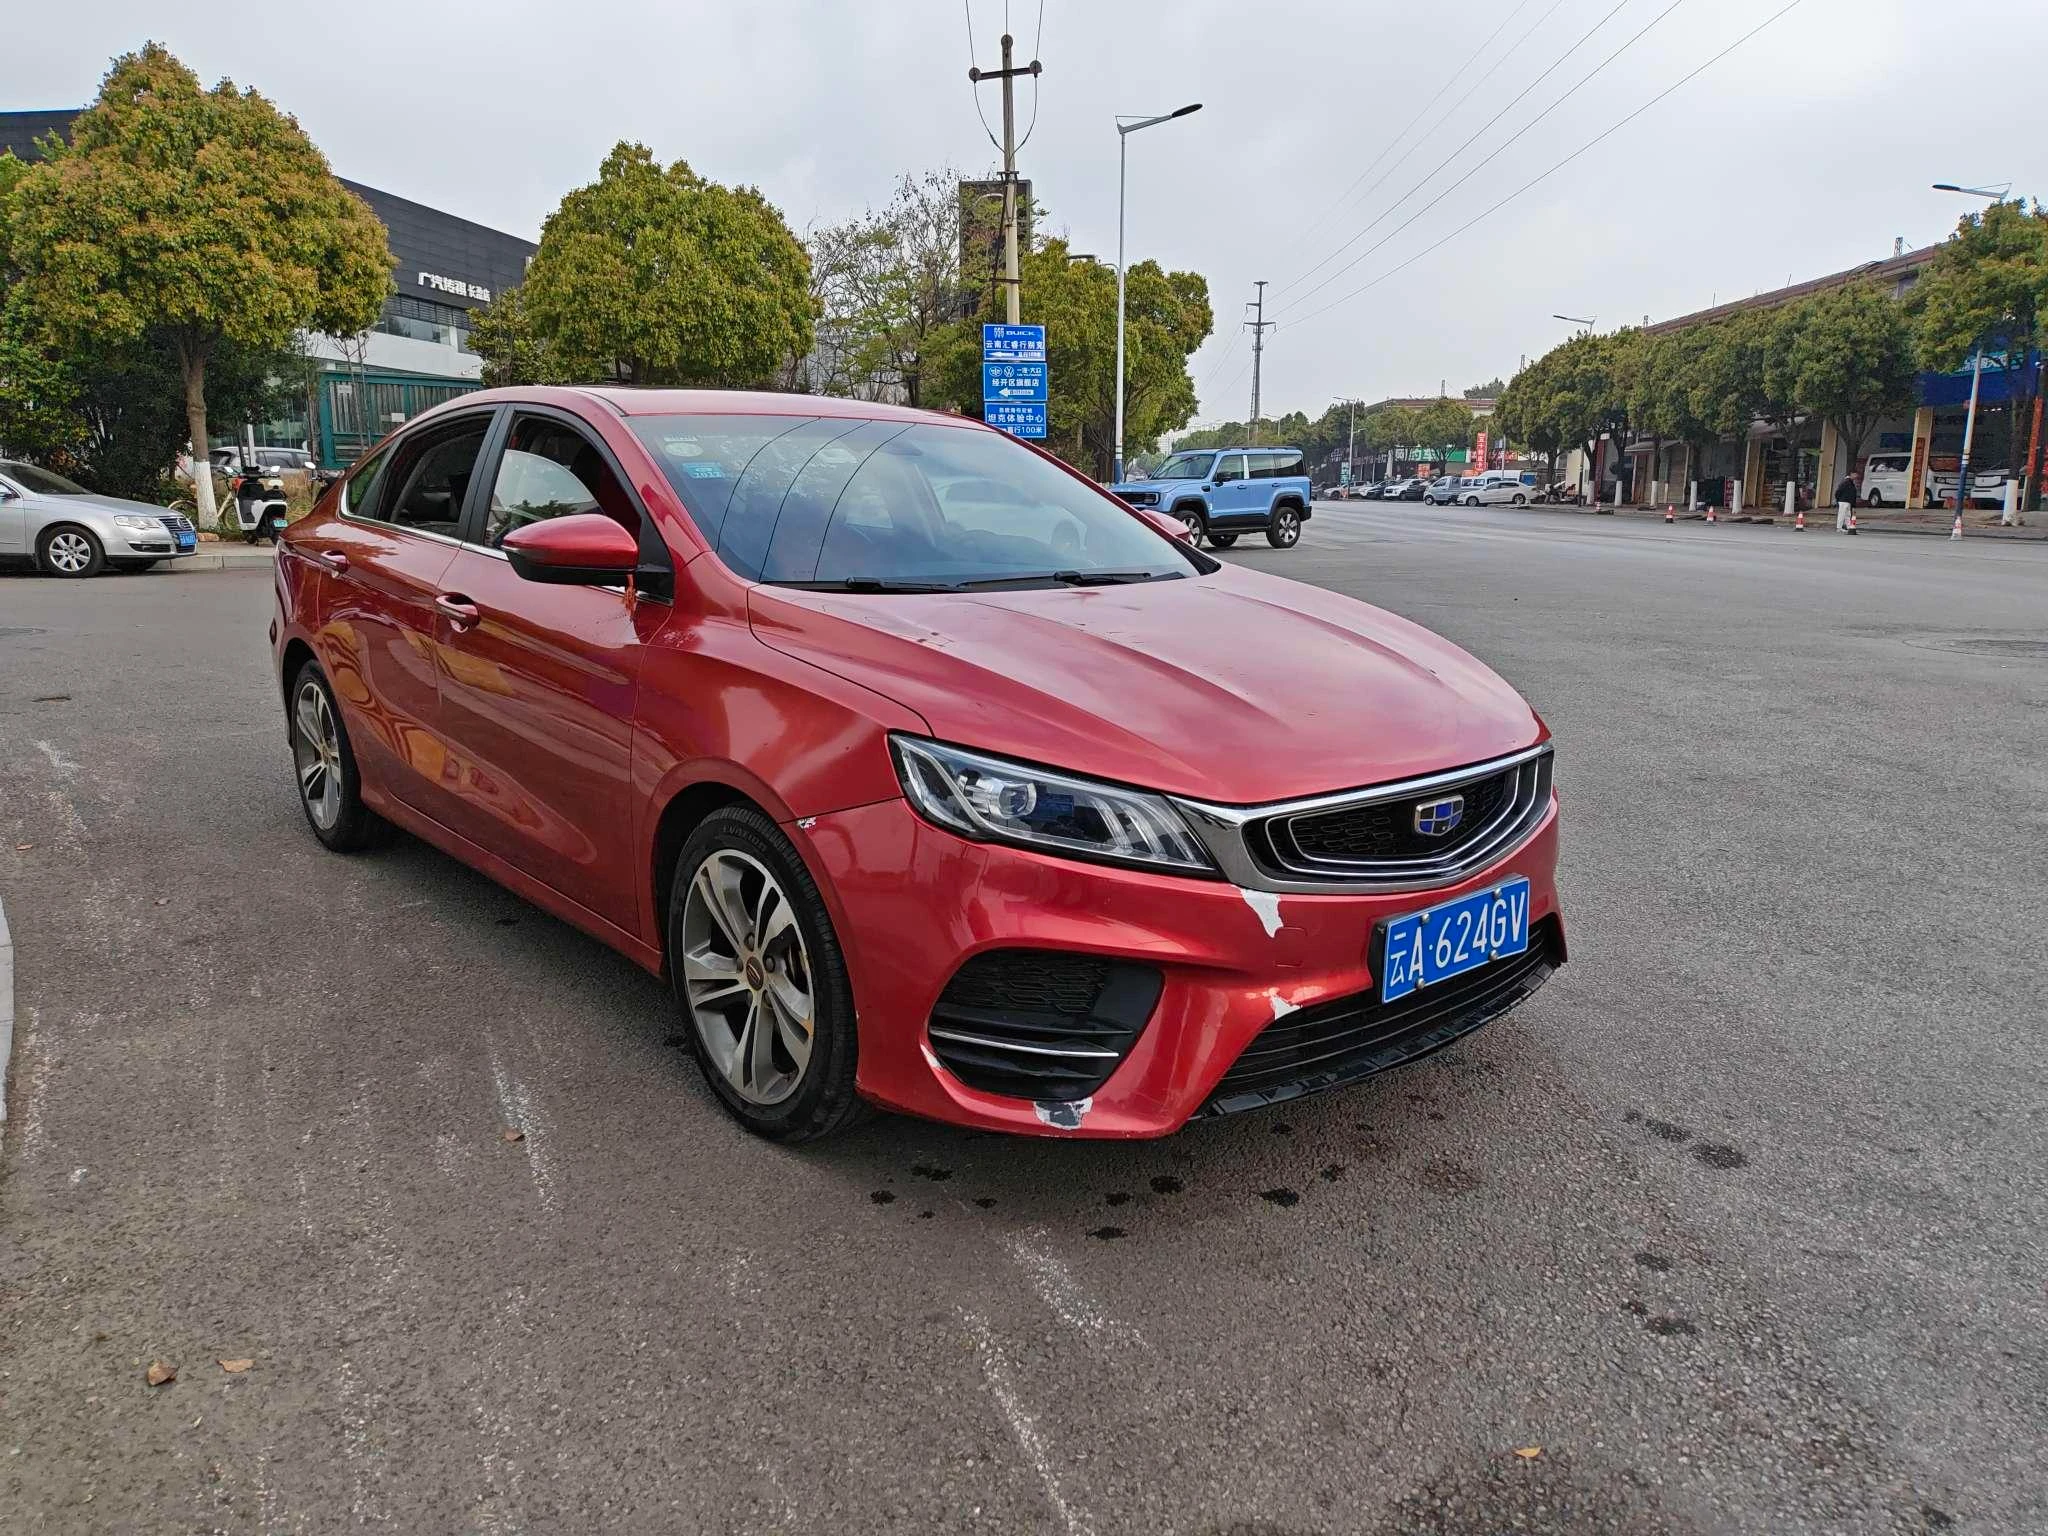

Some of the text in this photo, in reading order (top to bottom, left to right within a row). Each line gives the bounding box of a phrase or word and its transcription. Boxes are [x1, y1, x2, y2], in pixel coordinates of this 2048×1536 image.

[417, 271, 467, 297] 广汽传祺
[991, 378, 1040, 387] 经开区旗舰店
[988, 414, 1043, 423] 坦克体验中心
